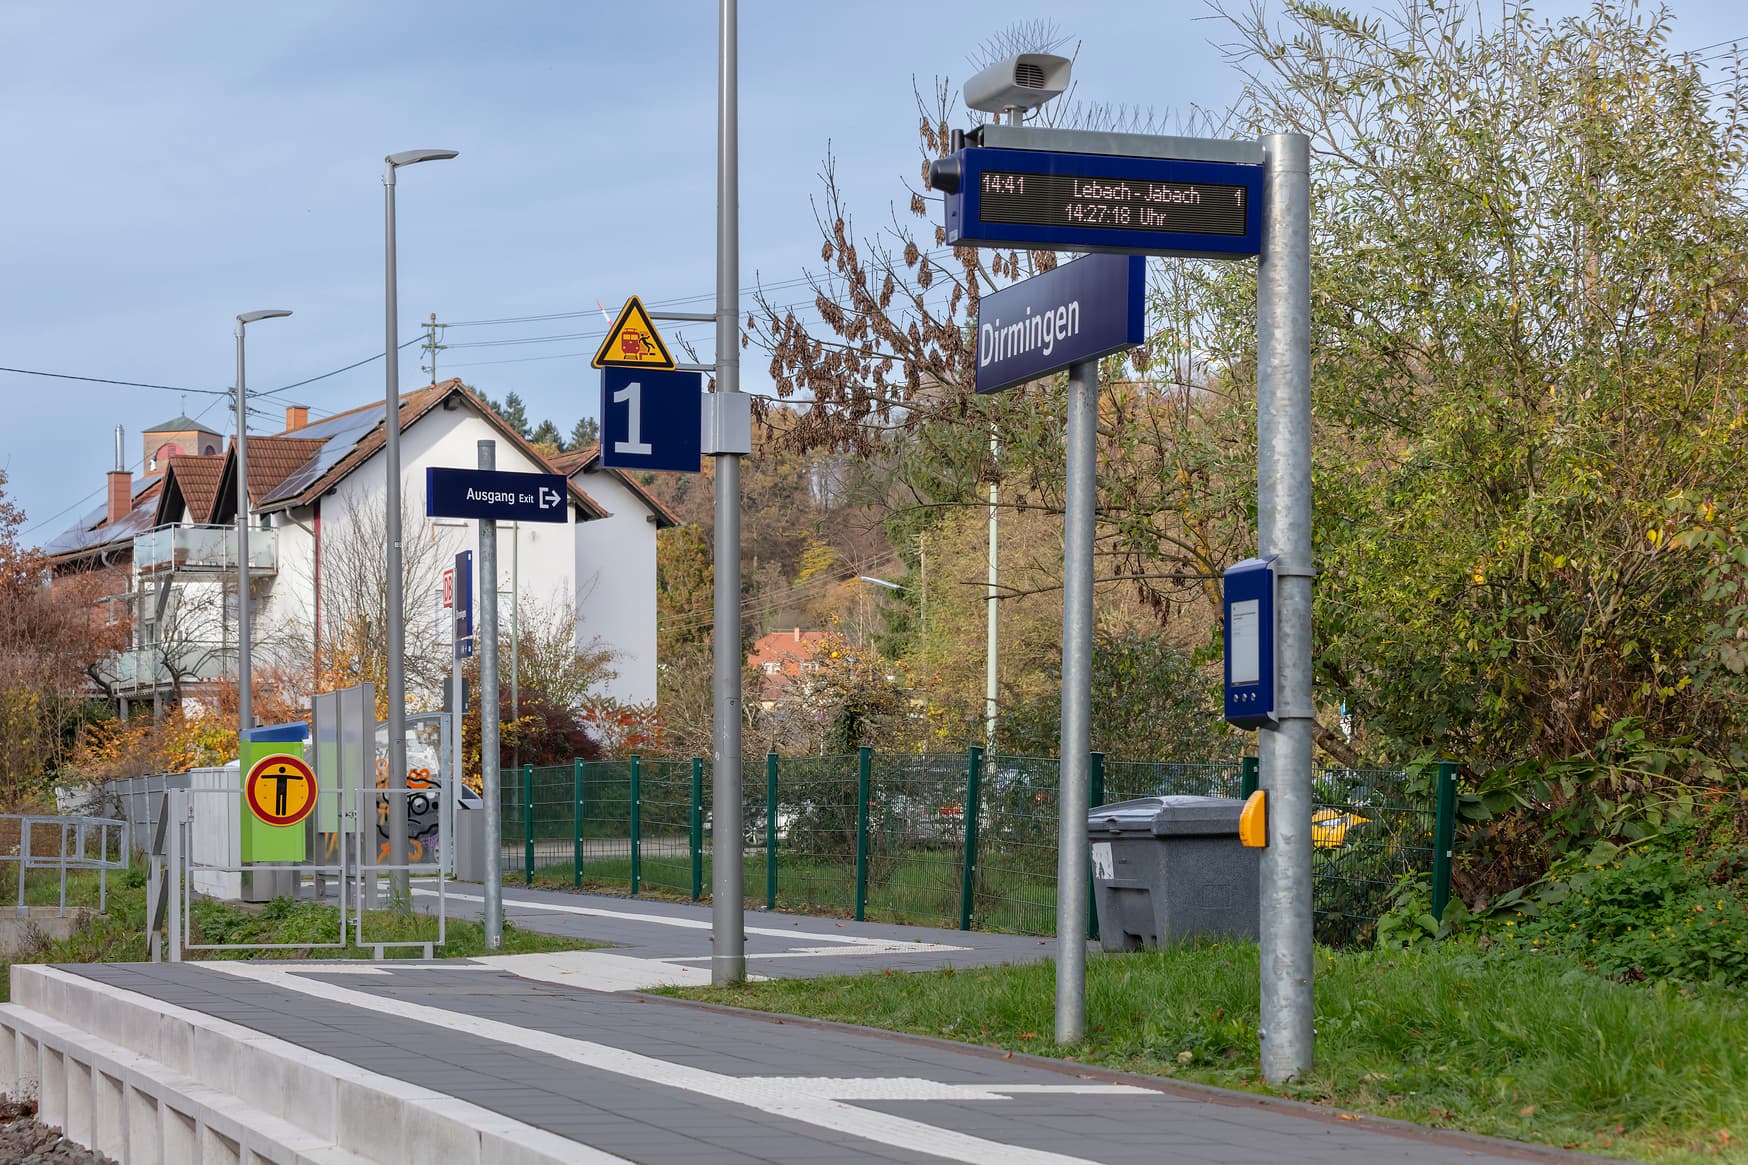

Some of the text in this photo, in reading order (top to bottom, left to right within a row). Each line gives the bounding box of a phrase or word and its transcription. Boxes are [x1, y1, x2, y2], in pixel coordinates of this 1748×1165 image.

[982, 174, 1025, 195] 14:41
[1234, 188, 1241, 207] 1
[1065, 203, 1167, 226] 14:27:18 Uhr
[980, 299, 1080, 369] Dirmingen
[613, 382, 653, 455] 1
[466, 487, 534, 505] Ausgang Exit
